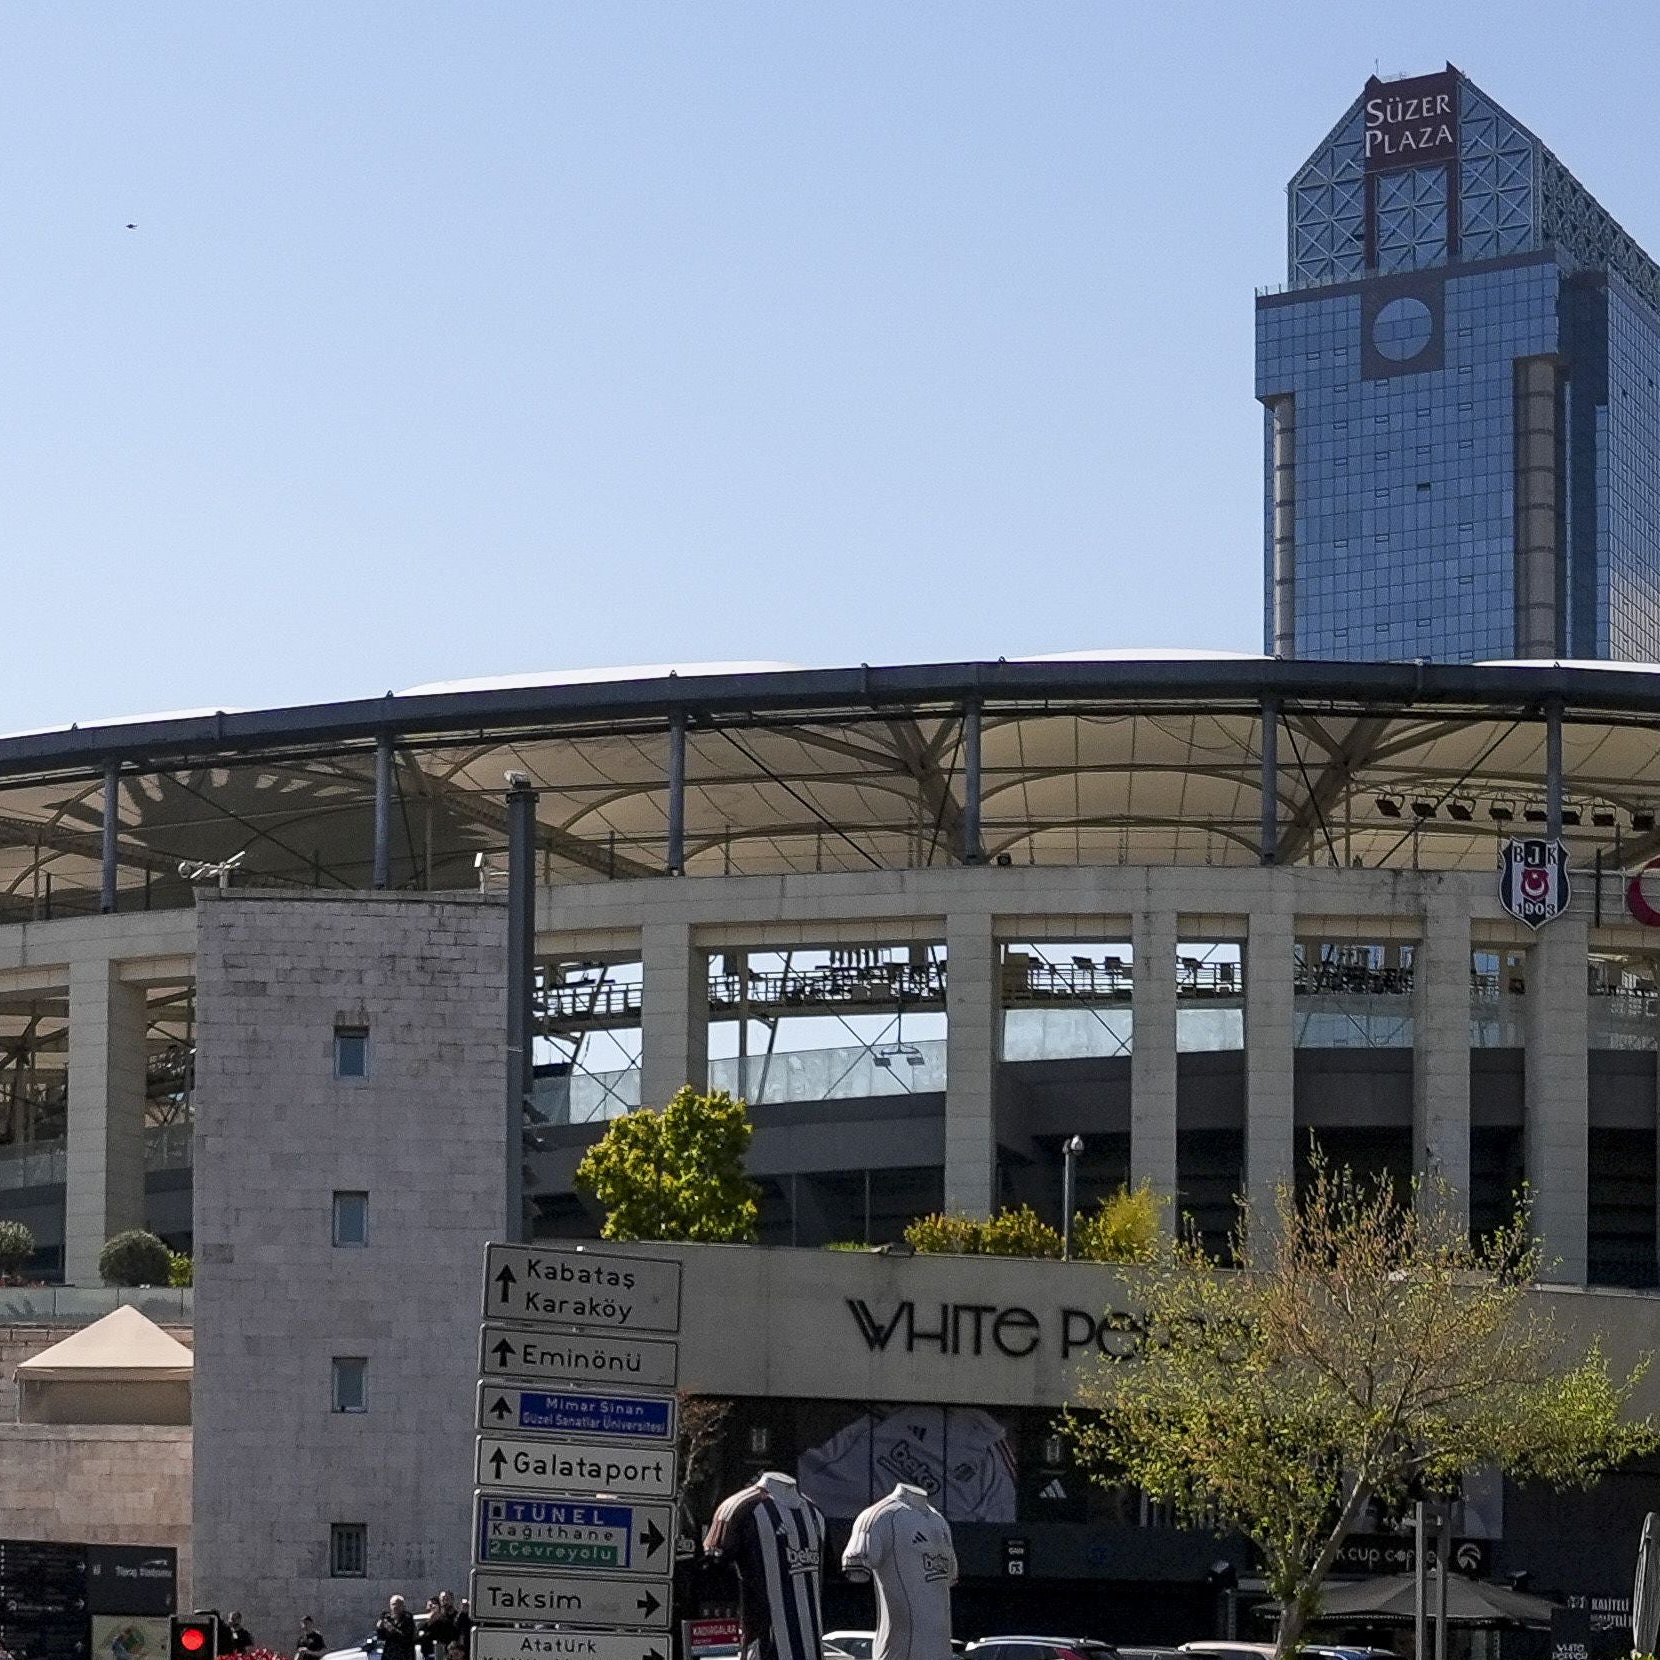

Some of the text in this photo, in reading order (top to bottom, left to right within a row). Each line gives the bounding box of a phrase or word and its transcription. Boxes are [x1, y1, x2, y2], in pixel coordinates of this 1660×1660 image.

[1365, 94, 1452, 127] SÜZER
[1365, 124, 1454, 158] PLAZA
[1513, 846, 1558, 866] BJK
[1514, 901, 1557, 917] 1903
[527, 1258, 636, 1290] Kabataş
[524, 1291, 633, 1325] Karaköy
[844, 1299, 1040, 1358] WHITE
[522, 1344, 641, 1373] Eminönü
[600, 1400, 645, 1416] Sinan
[513, 1451, 664, 1486] Galataport
[512, 1503, 605, 1525] TÜNEL
[491, 1522, 614, 1542] Kağıthane
[487, 1586, 582, 1609] Taksim
[519, 1636, 597, 1654] Atatürk
